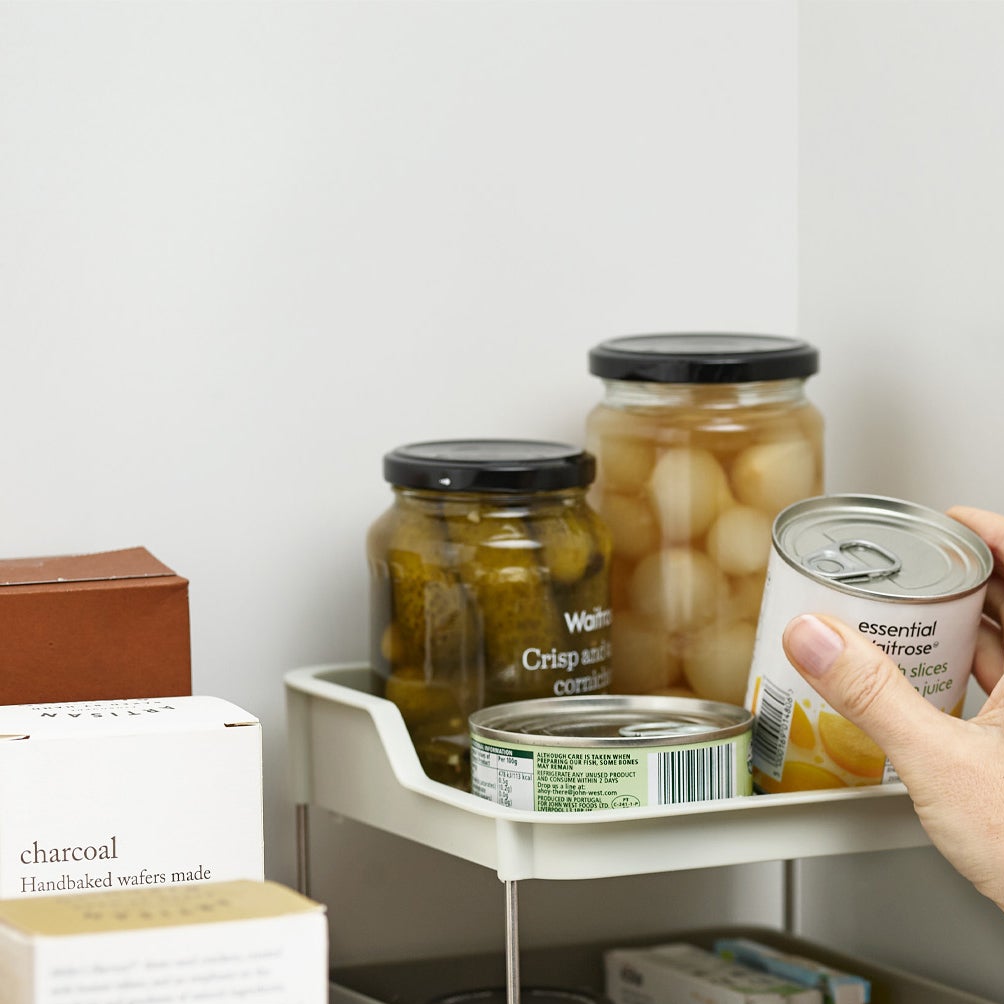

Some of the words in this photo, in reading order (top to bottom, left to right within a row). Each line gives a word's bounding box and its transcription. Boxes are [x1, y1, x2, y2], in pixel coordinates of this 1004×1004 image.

[858, 620, 937, 638] essential
[873, 640, 933, 656] aitrose
[522, 647, 580, 672] Crisp
[910, 661, 948, 679] slices
[922, 679, 953, 698] juice
[40, 695, 176, 718] ARTISAN
[522, 773, 533, 781] kcal
[20, 836, 118, 865] charcoal
[20, 872, 113, 893] Handbaked
[117, 868, 166, 887] wafers
[171, 865, 212, 883] made
